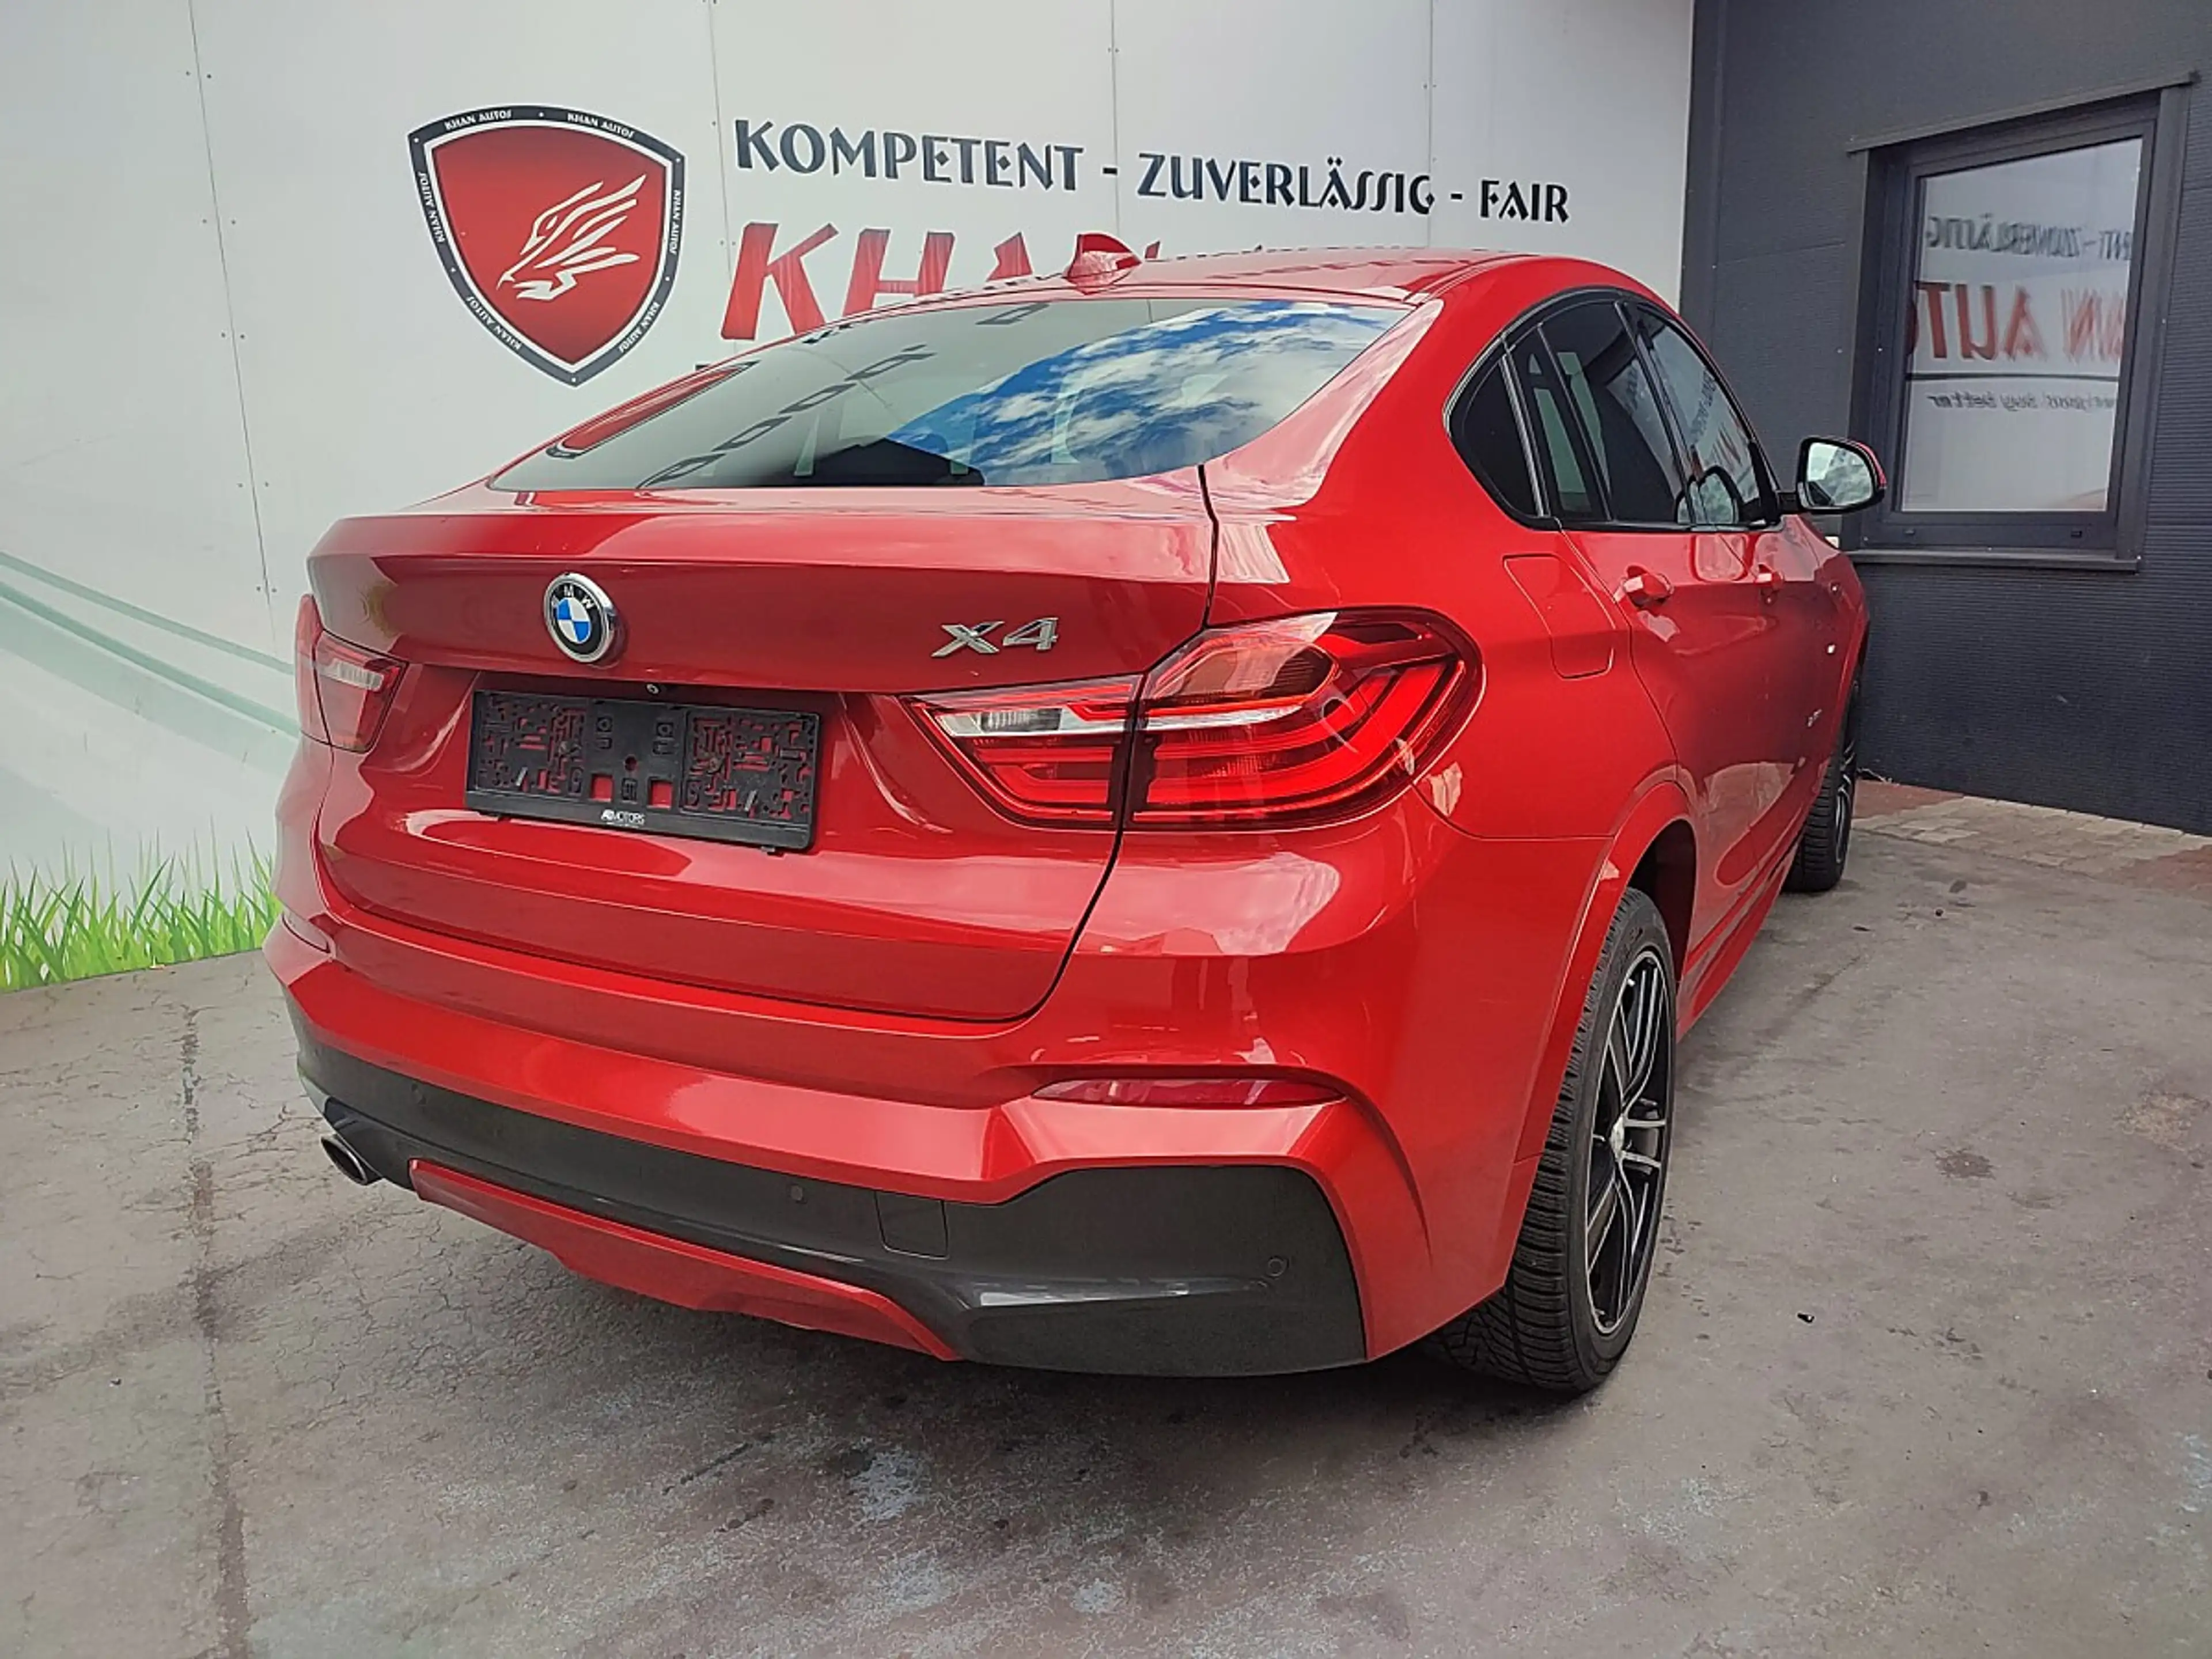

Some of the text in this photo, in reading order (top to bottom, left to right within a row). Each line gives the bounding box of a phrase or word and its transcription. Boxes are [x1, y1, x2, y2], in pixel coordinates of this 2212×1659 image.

[444, 109, 512, 130] KHAN AUTOS
[567, 113, 634, 138] KHAN AUTOS
[734, 119, 1084, 192] KOMPETENT
[1137, 152, 1435, 215] ZUVERLÄSSIG
[1479, 179, 1570, 224] FAIR
[428, 210, 445, 242] KHAN
[931, 617, 1059, 657] X4
